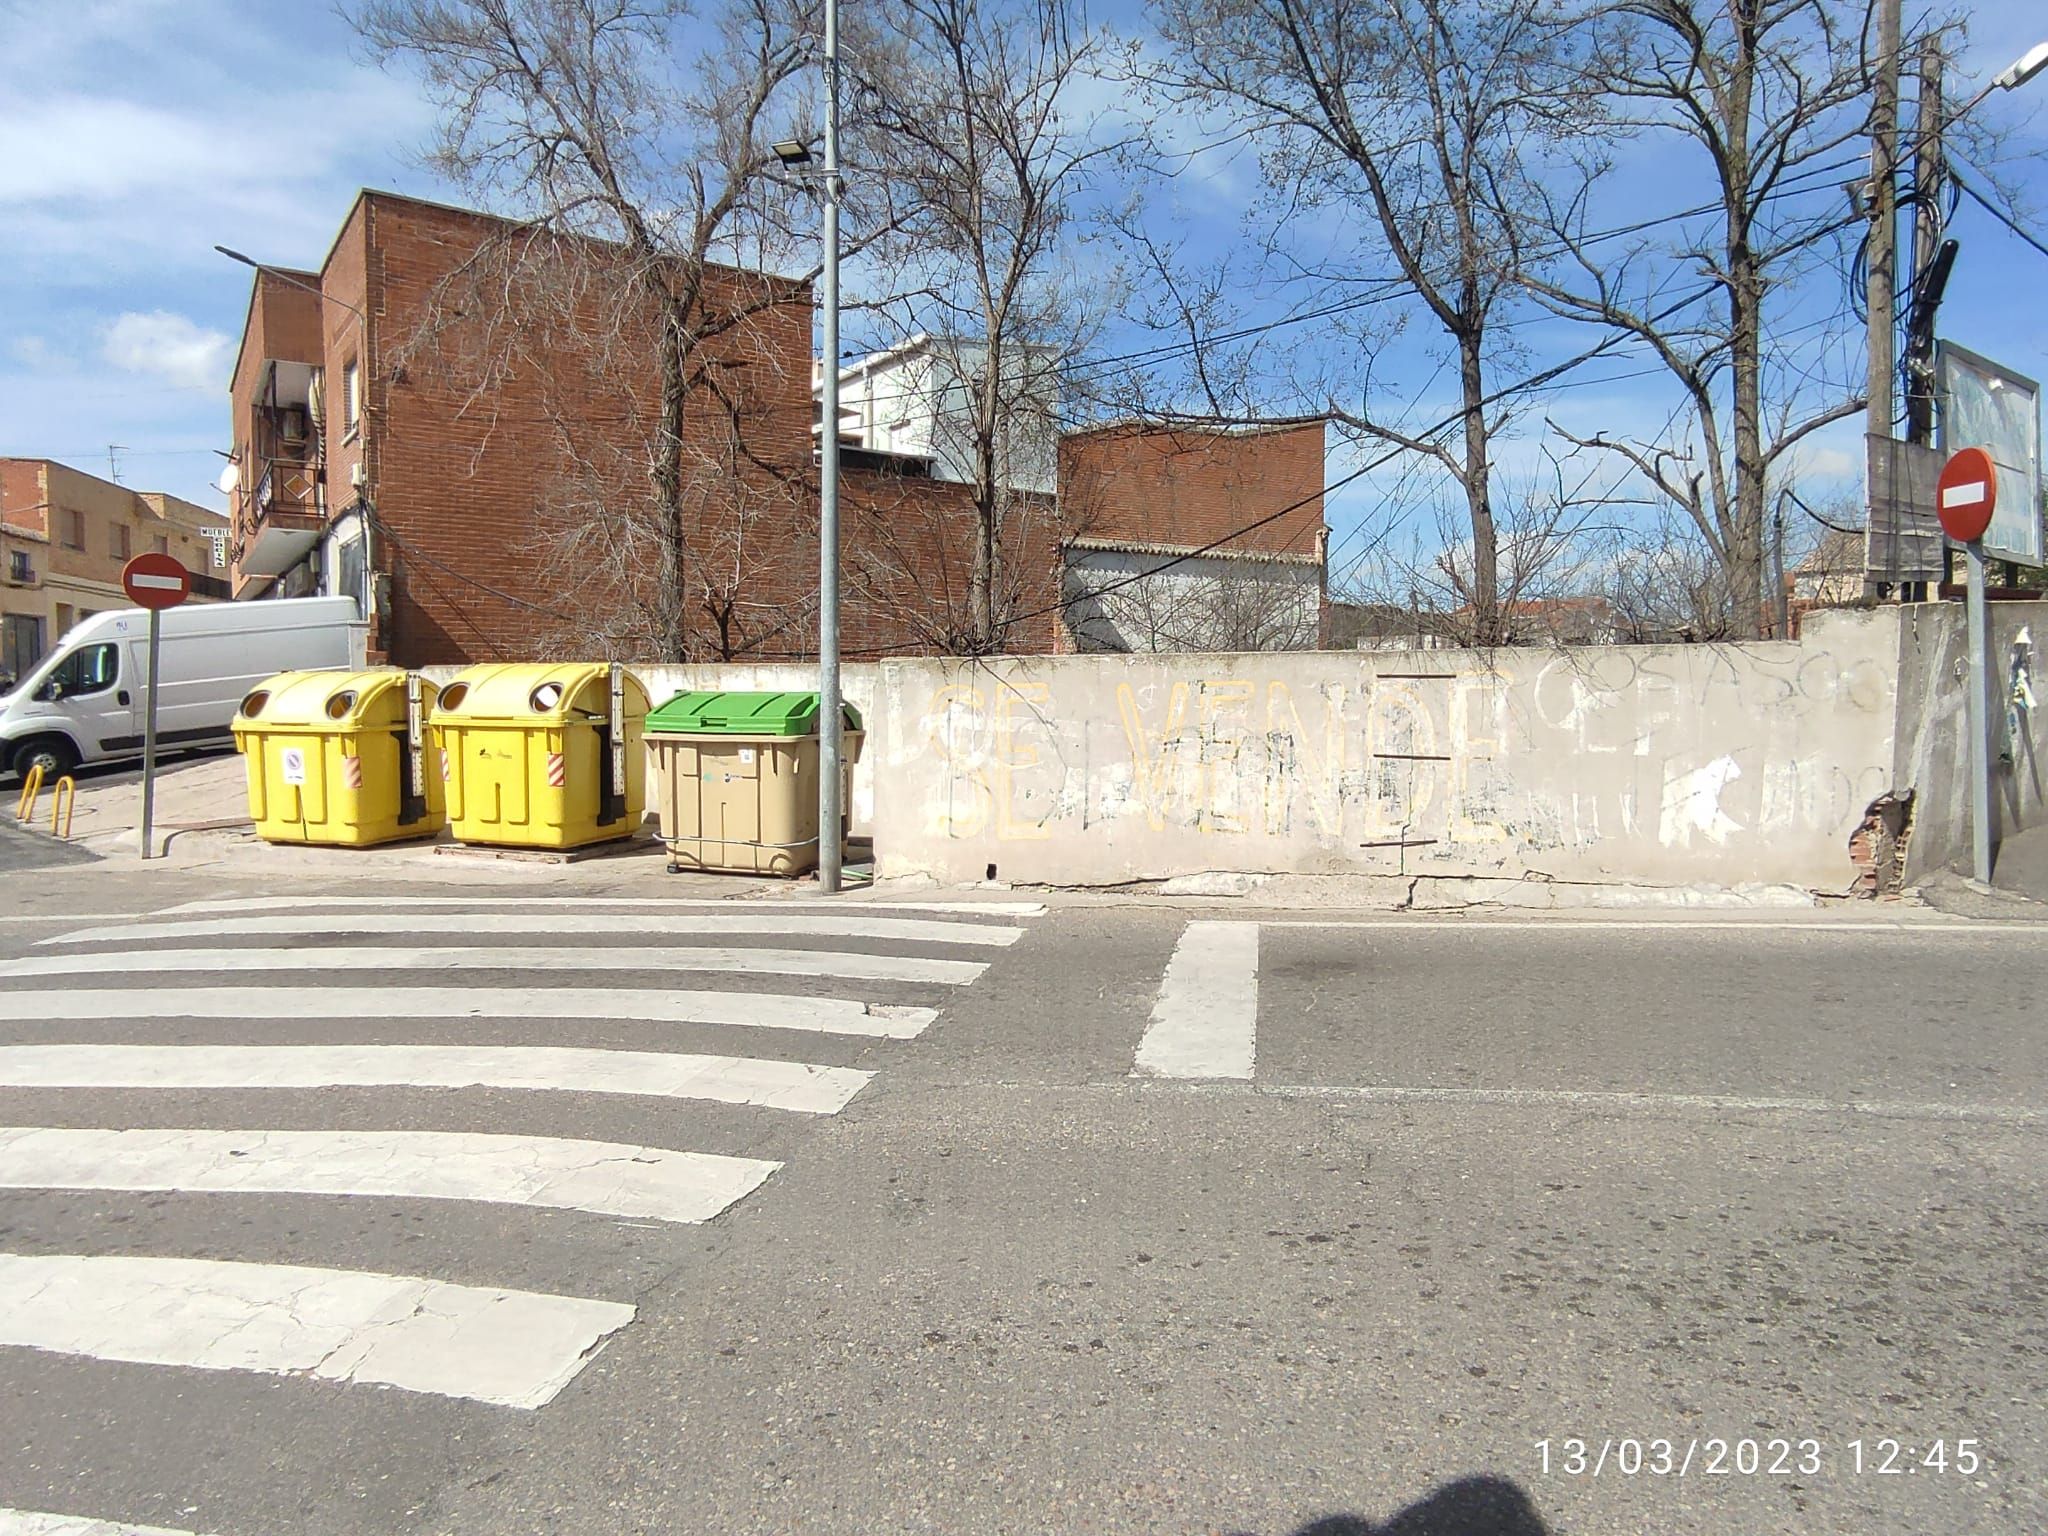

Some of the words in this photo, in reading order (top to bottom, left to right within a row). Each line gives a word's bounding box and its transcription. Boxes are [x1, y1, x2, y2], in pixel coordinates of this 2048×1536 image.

[201, 528, 232, 537] MUEBLE
[928, 681, 1053, 841] SE
[1114, 669, 1515, 844] VENDE
